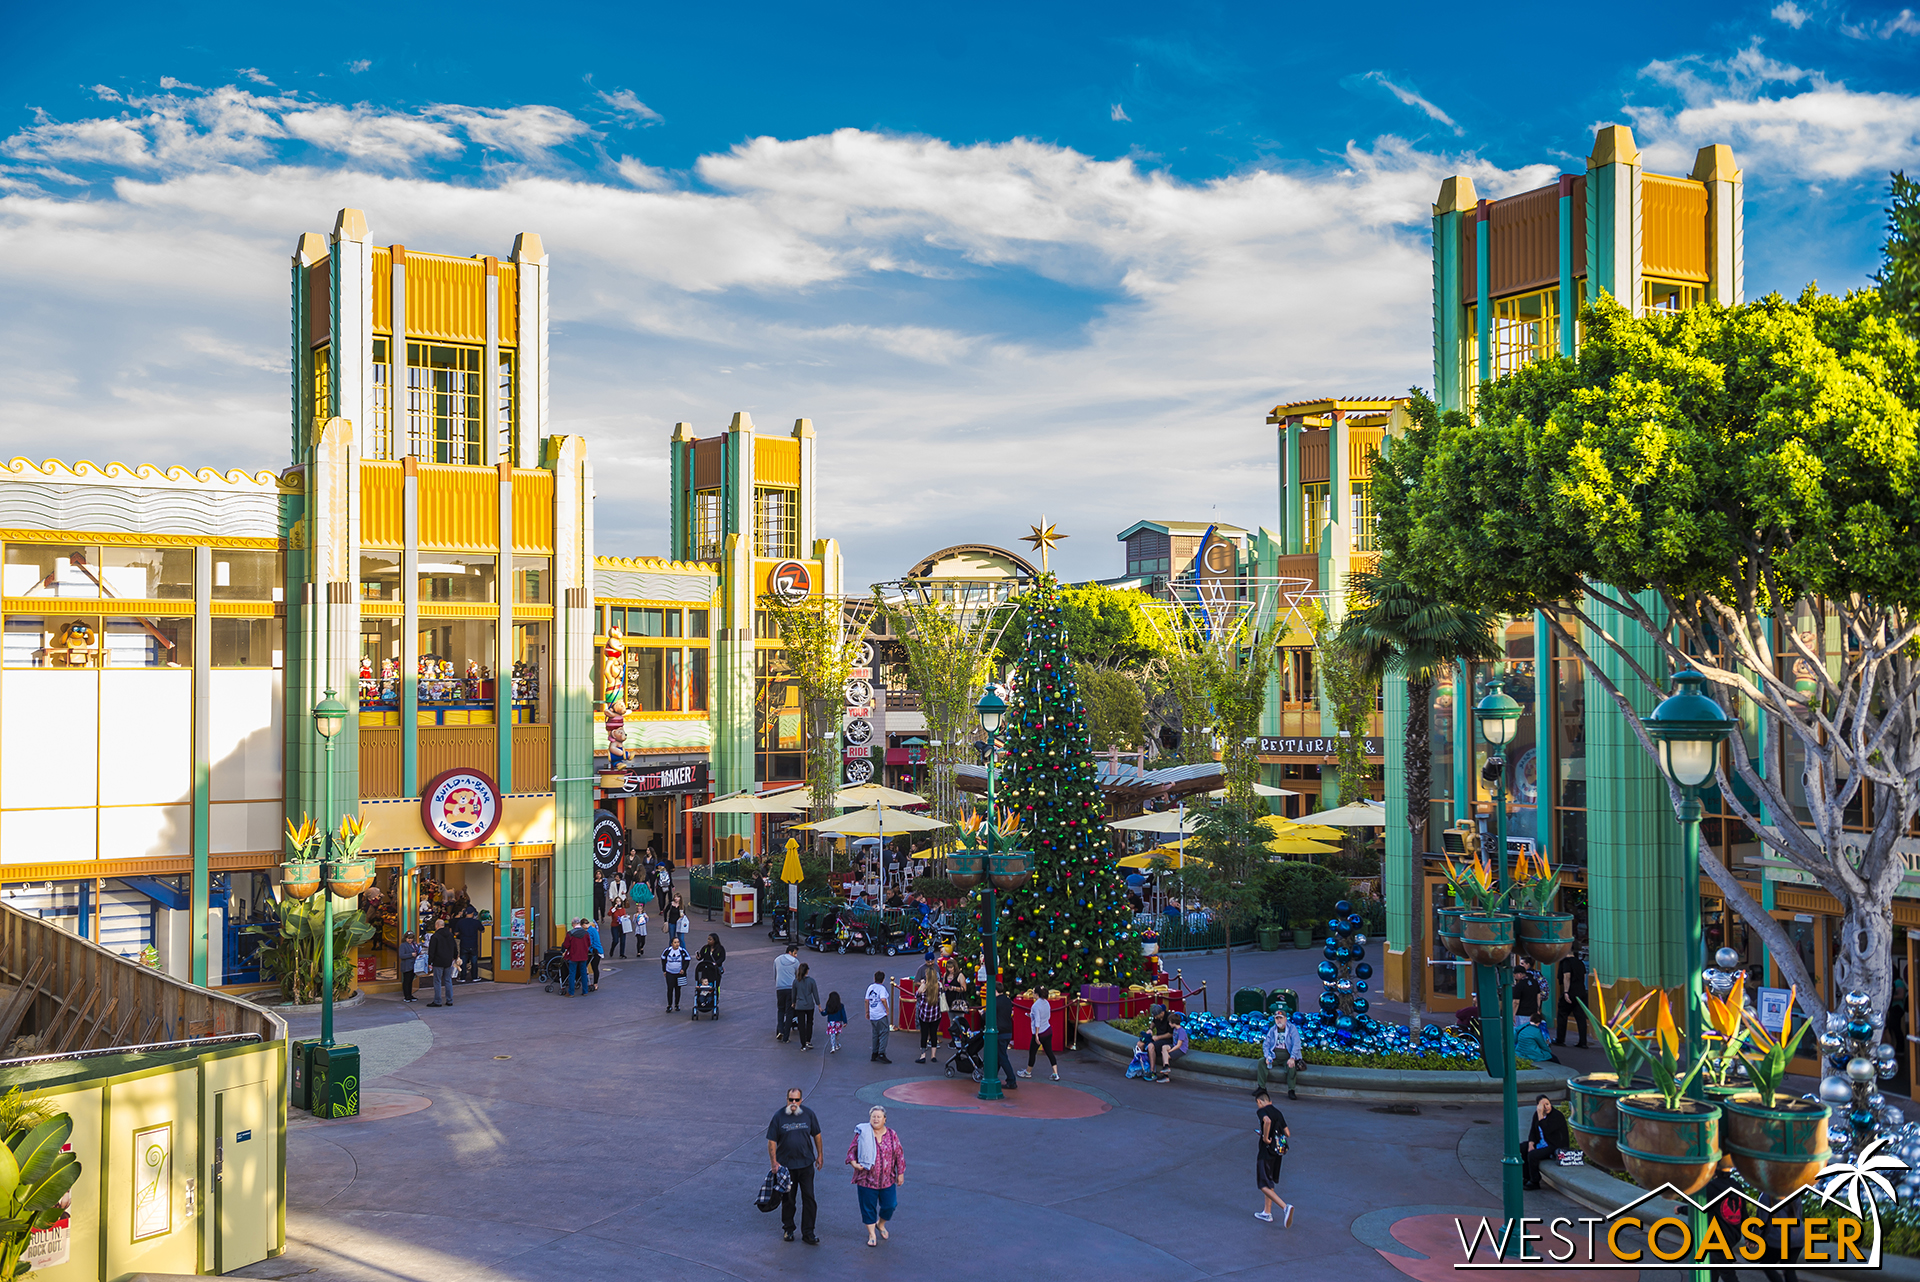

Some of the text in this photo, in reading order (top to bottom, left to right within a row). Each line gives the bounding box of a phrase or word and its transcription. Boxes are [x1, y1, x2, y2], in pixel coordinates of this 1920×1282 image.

[848, 707, 869, 718] YOUR
[849, 747, 869, 757] RIDE
[1260, 738, 1377, 754] RESTAURA &
[639, 765, 697, 792] RIDEMAKERZ
[438, 820, 486, 838] WORKSHOP
[31, 1226, 62, 1246] ROLL IN.
[28, 1239, 63, 1259] ROCK OUT.
